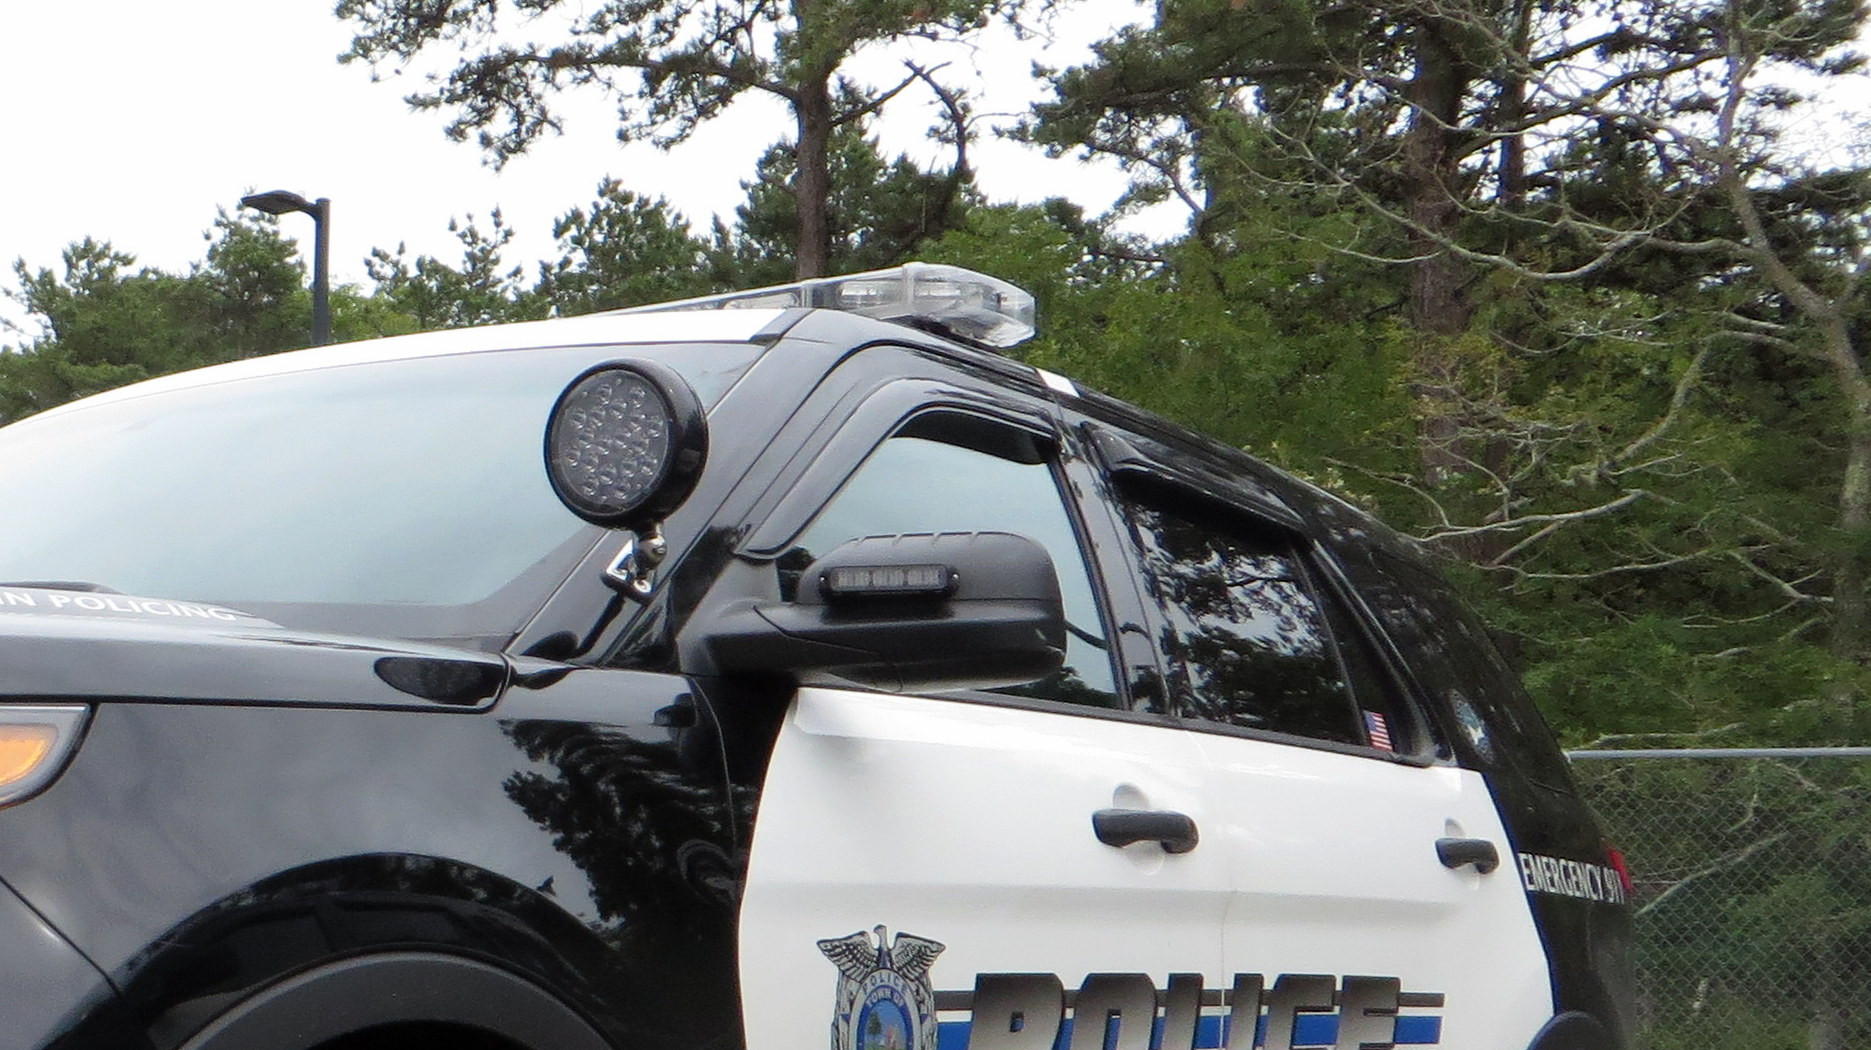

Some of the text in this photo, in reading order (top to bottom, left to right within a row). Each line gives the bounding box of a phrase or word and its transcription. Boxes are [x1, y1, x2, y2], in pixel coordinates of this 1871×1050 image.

[49, 594, 237, 622] POLICING
[1517, 852, 1625, 904] EMERGENCY 911
[862, 972, 909, 996] POLICE
